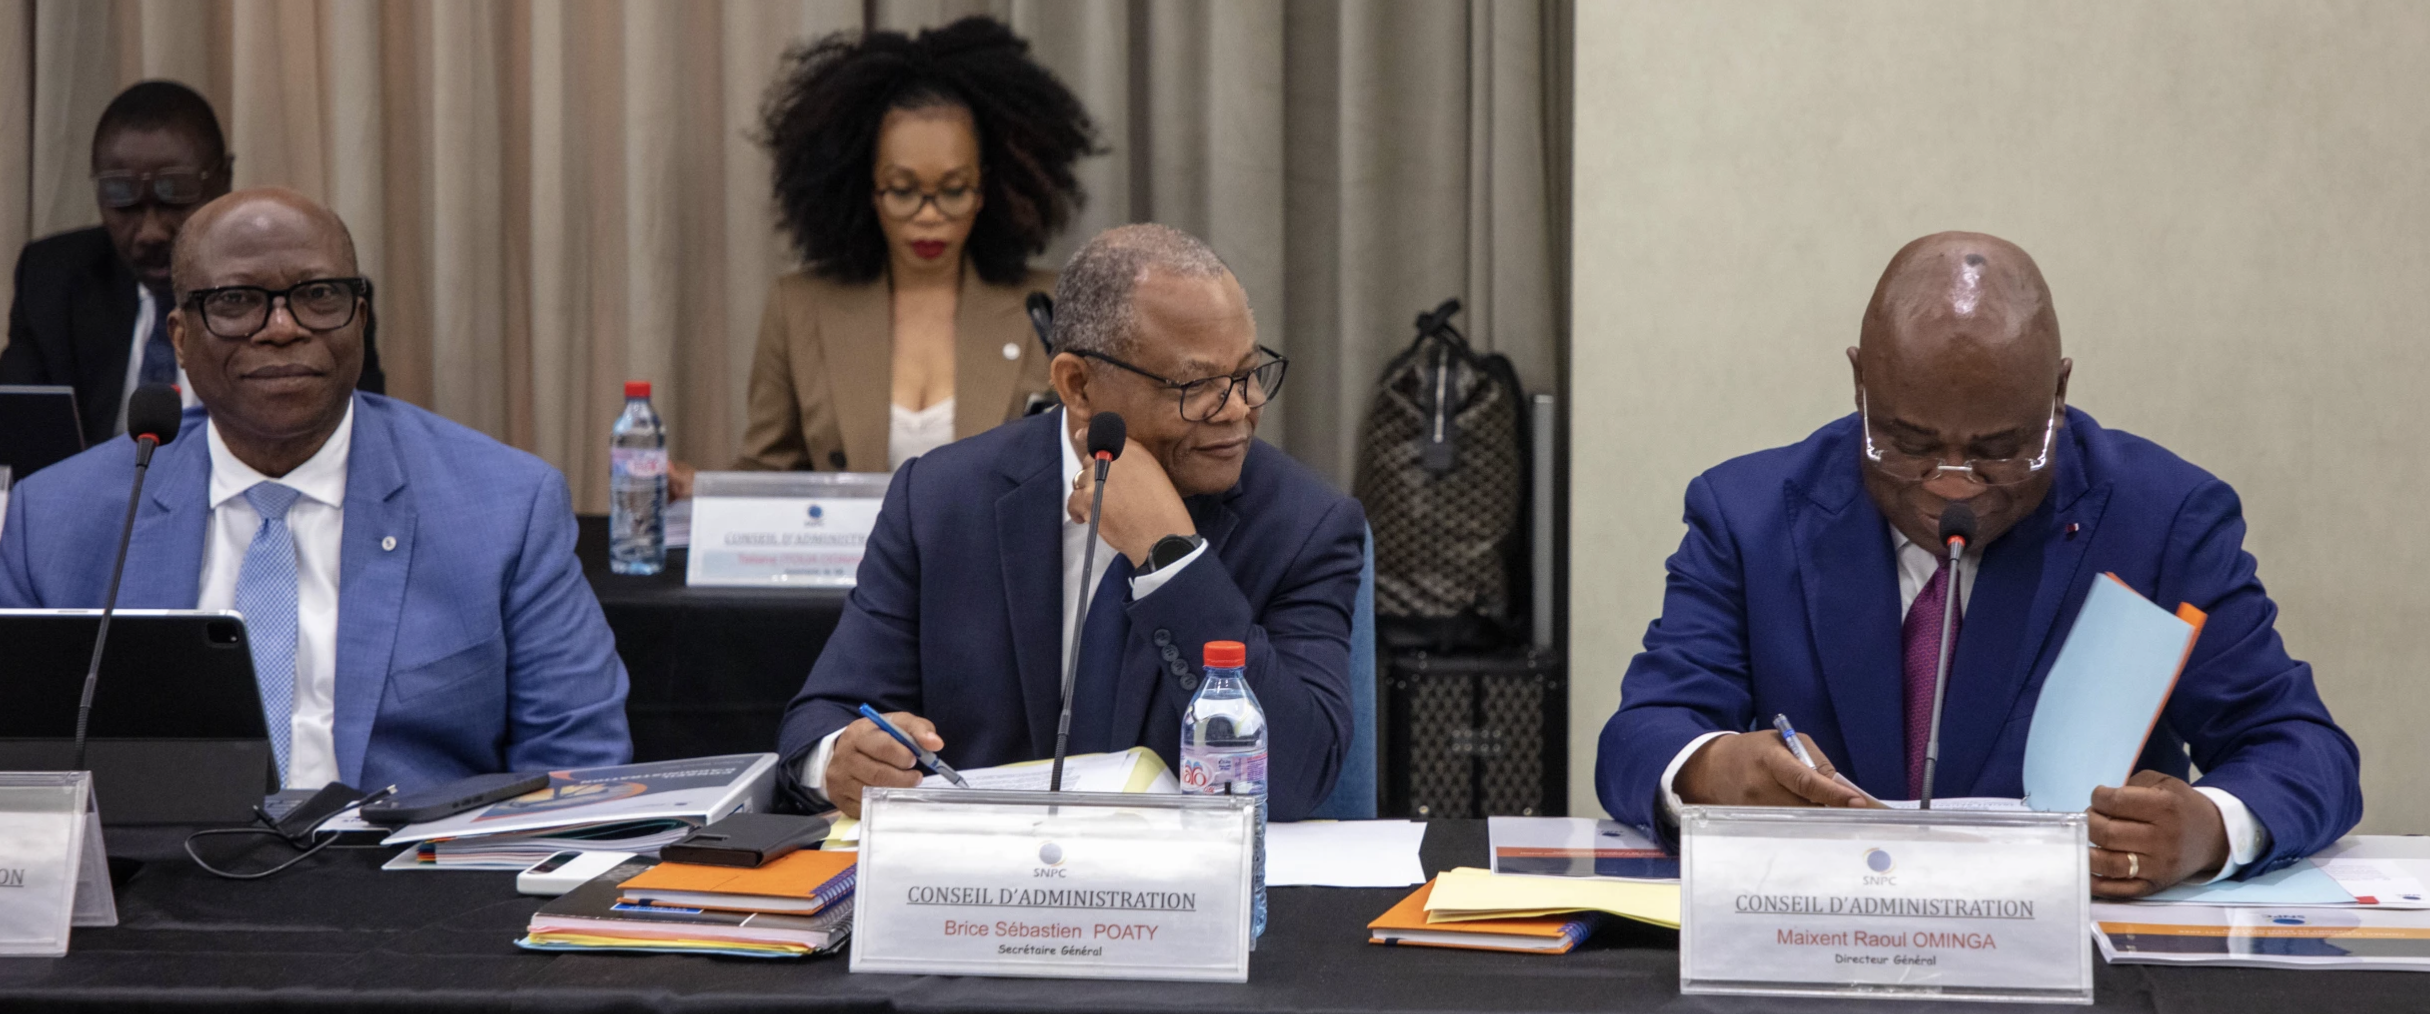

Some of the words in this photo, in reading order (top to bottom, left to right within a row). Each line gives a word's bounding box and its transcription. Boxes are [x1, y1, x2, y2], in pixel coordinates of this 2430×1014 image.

[1033, 868, 1067, 879] SNPC
[1862, 876, 1897, 886] SNPC
[907, 886, 993, 905] CONSEIL
[1735, 894, 1824, 913] CONSEIL
[944, 920, 989, 938] Brice
[995, 921, 1082, 939] Sébastien
[1094, 924, 1158, 940] POATY
[1777, 929, 1848, 947] Maixent
[1854, 931, 1907, 948] Raoul
[1913, 932, 1996, 949] OMINGA
[998, 944, 1056, 955] Secrétaire
[1061, 945, 1102, 957] Général
[1835, 953, 1889, 965] Directeur
[1893, 955, 1937, 966] Général
